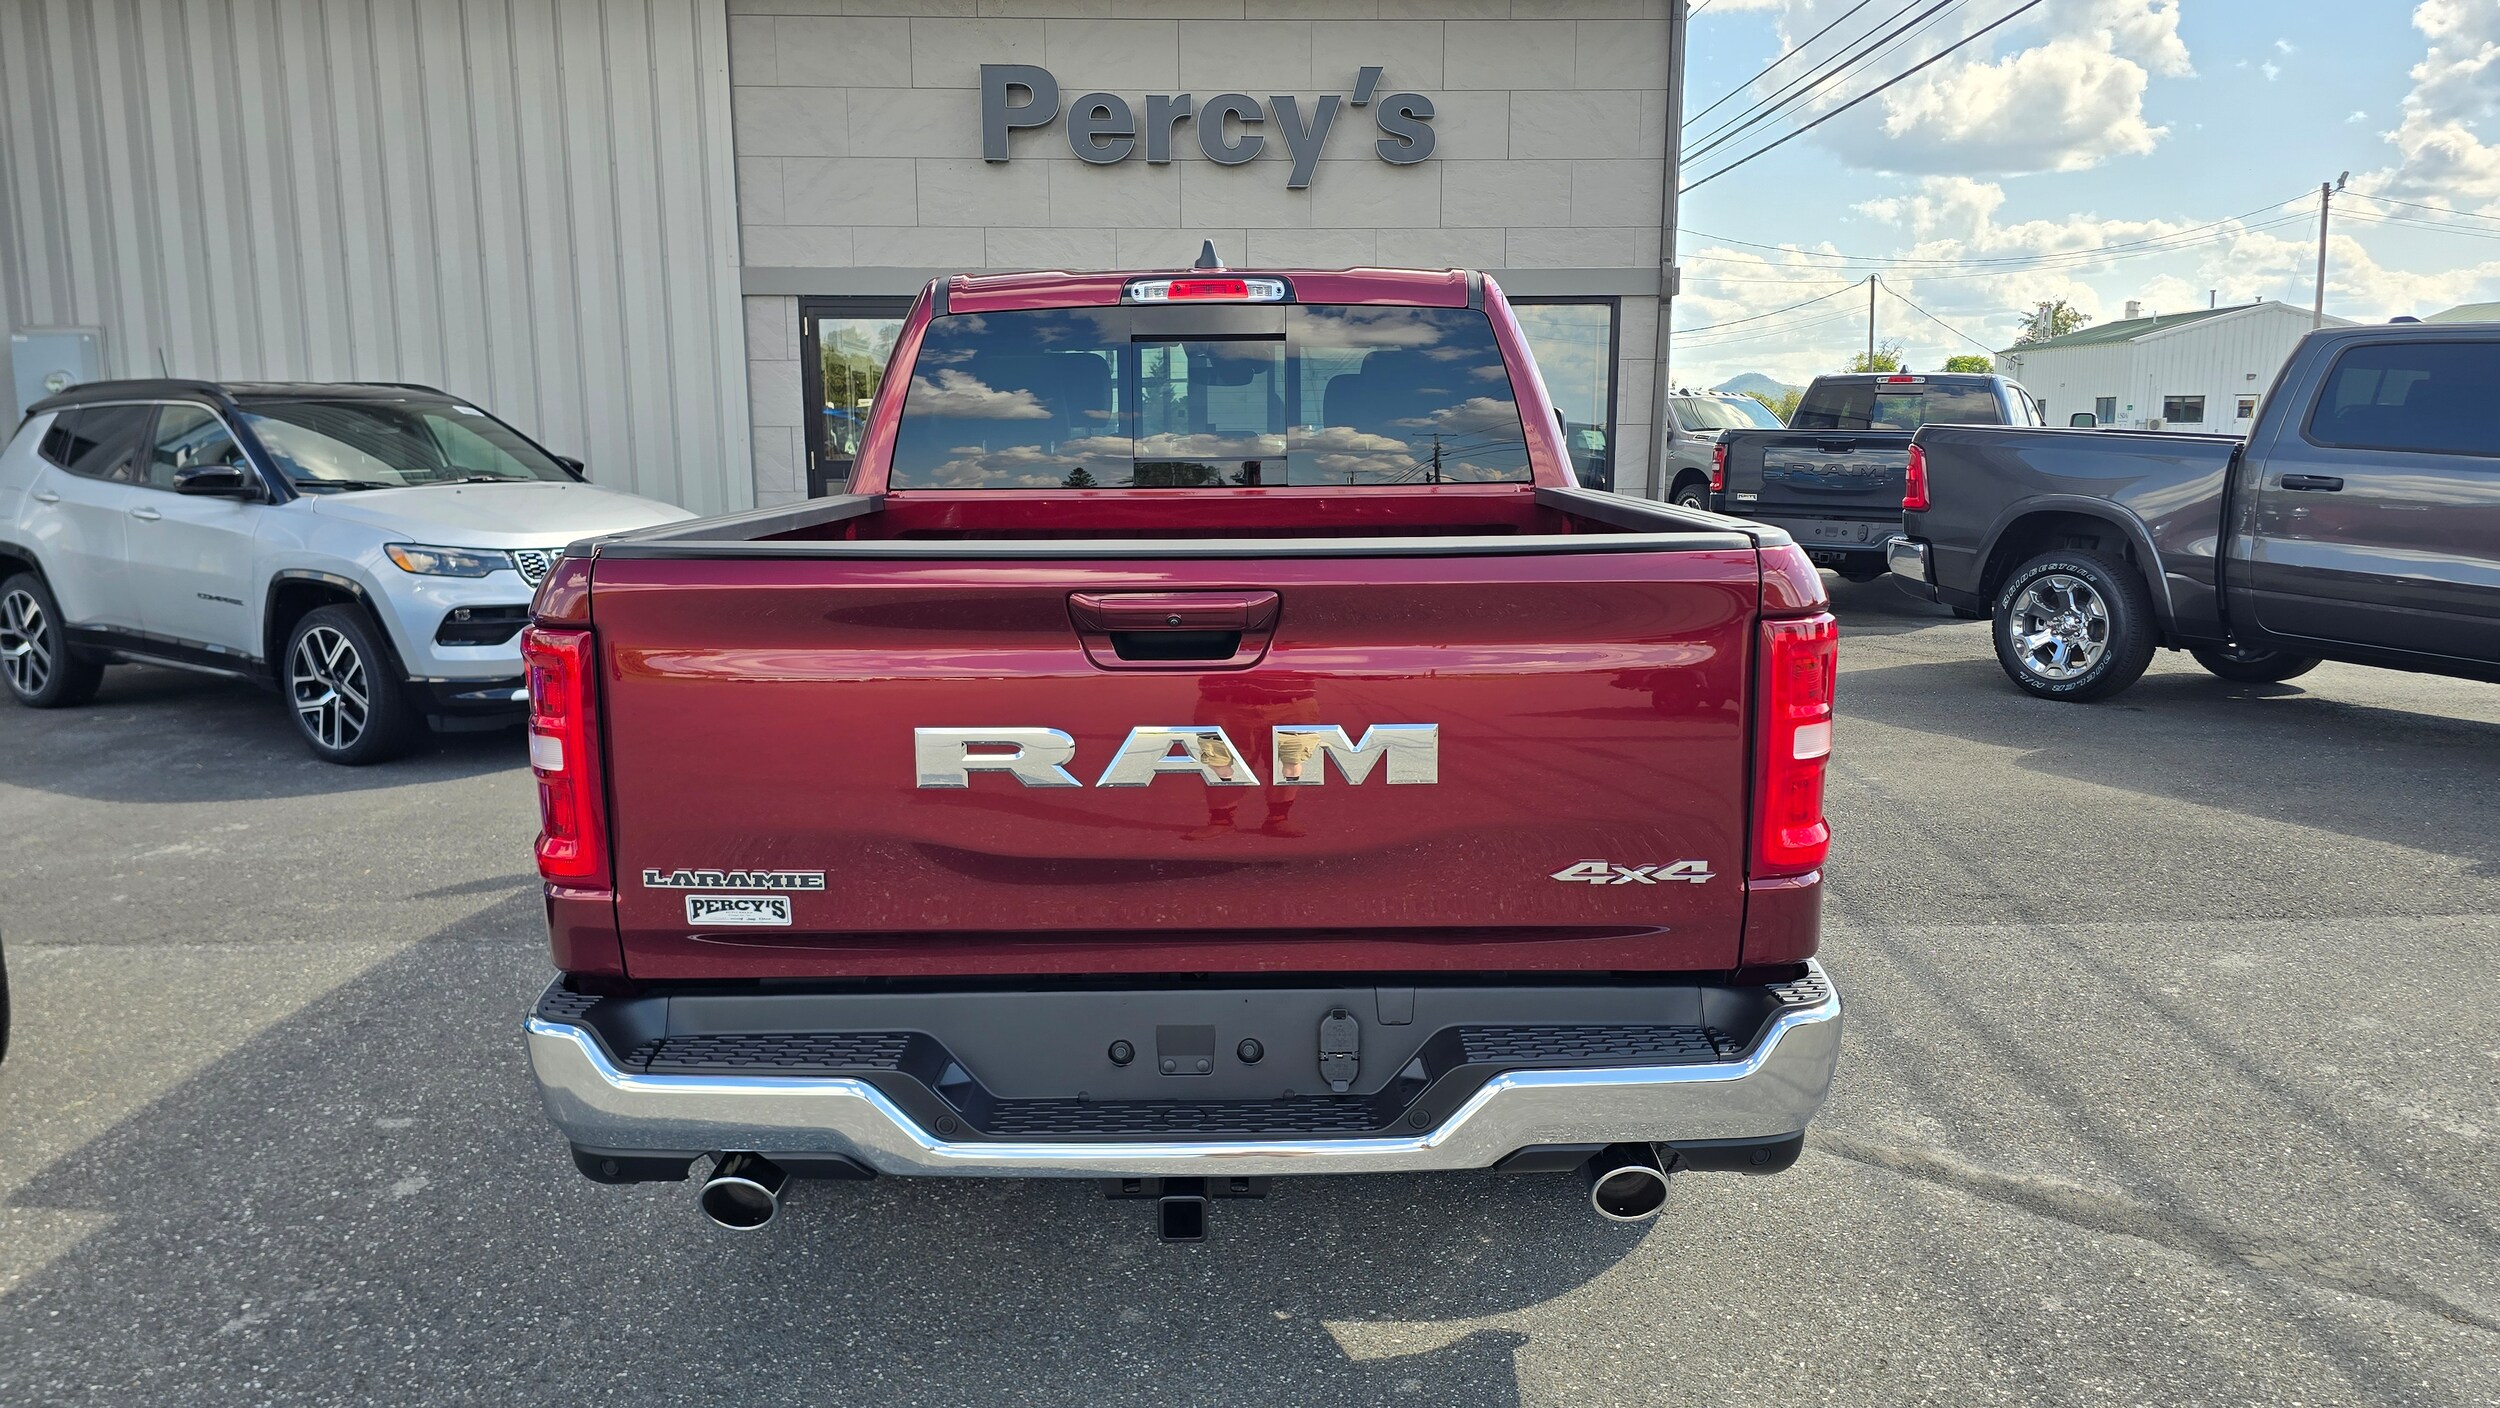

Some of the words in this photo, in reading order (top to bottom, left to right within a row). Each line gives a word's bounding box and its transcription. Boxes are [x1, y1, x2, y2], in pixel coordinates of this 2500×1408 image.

[979, 63, 1437, 189] Percy's
[1784, 462, 1887, 478] RAM
[2002, 563, 2098, 609] BRIDGESTONE
[914, 723, 1439, 789] RAM
[642, 868, 826, 891] LARAMIE
[1549, 859, 1717, 885] 4x4
[691, 899, 787, 920] PERCY'S
